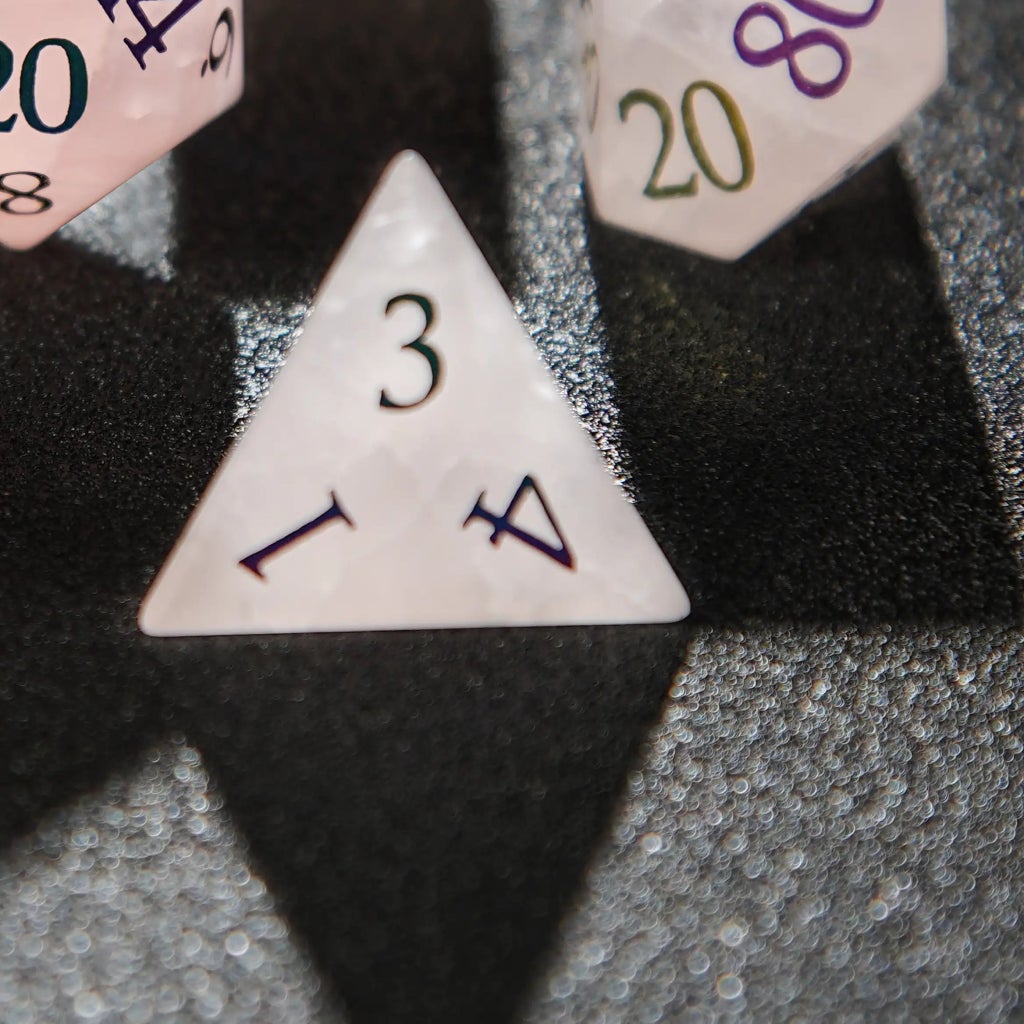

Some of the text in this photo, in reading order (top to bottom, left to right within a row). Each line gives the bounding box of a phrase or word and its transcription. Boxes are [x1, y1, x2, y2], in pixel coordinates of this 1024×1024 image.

[618, 80, 756, 201] 20
[379, 294, 444, 413] 3
[237, 489, 357, 585] 1
[462, 474, 578, 573] 4
